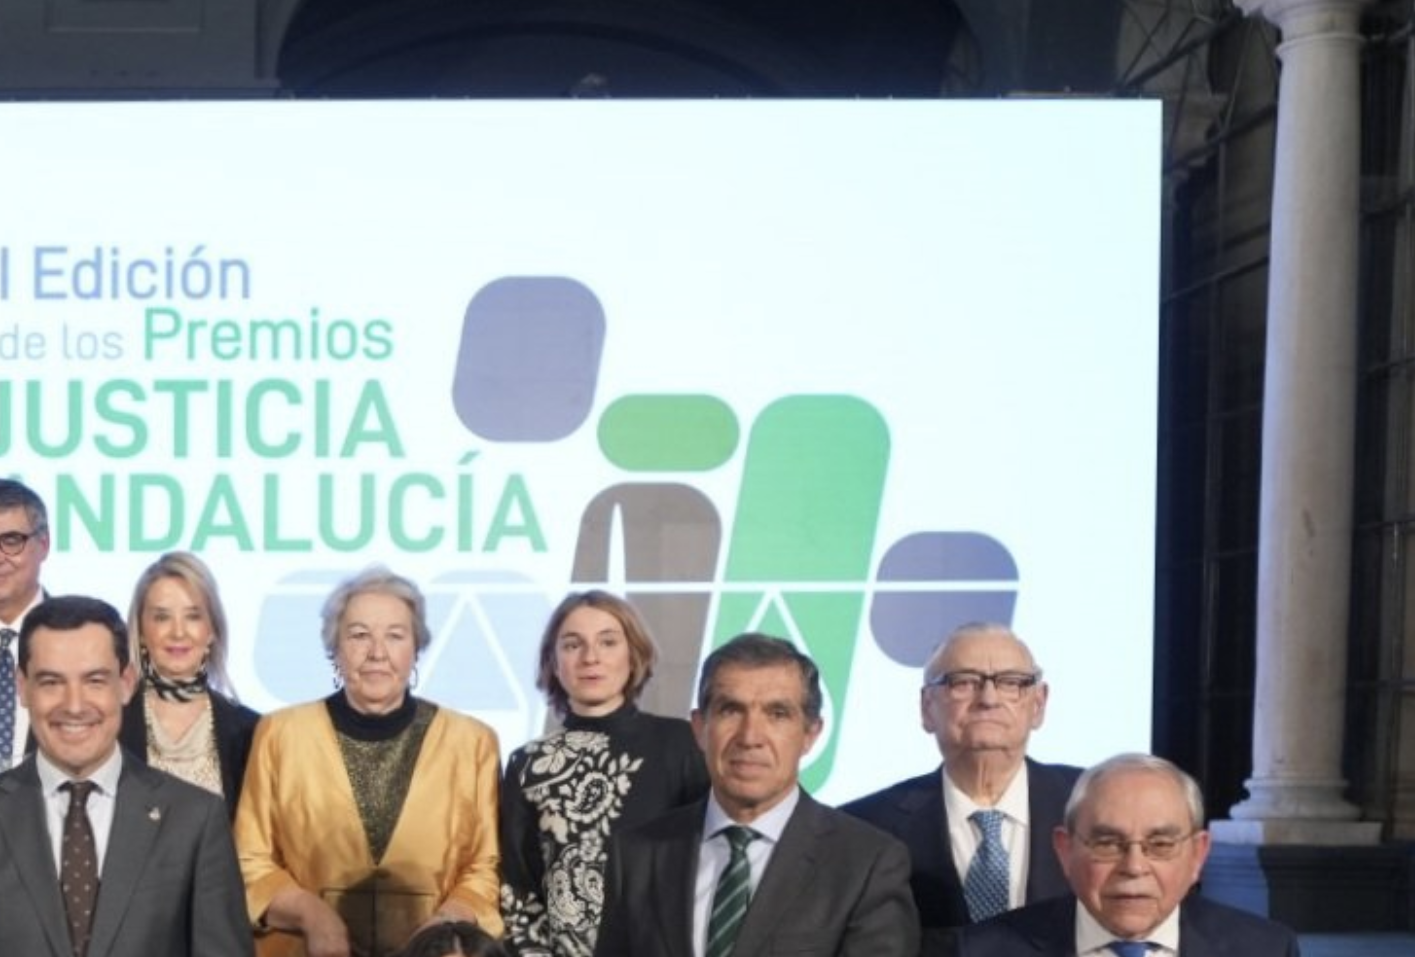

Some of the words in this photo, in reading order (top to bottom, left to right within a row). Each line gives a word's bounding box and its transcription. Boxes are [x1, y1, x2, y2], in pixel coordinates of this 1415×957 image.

[0, 246, 10, 301] I
[33, 243, 251, 301] Edición
[62, 323, 123, 361] los
[143, 306, 395, 362] Premios
[8, 450, 549, 553] NDALUCÍA
